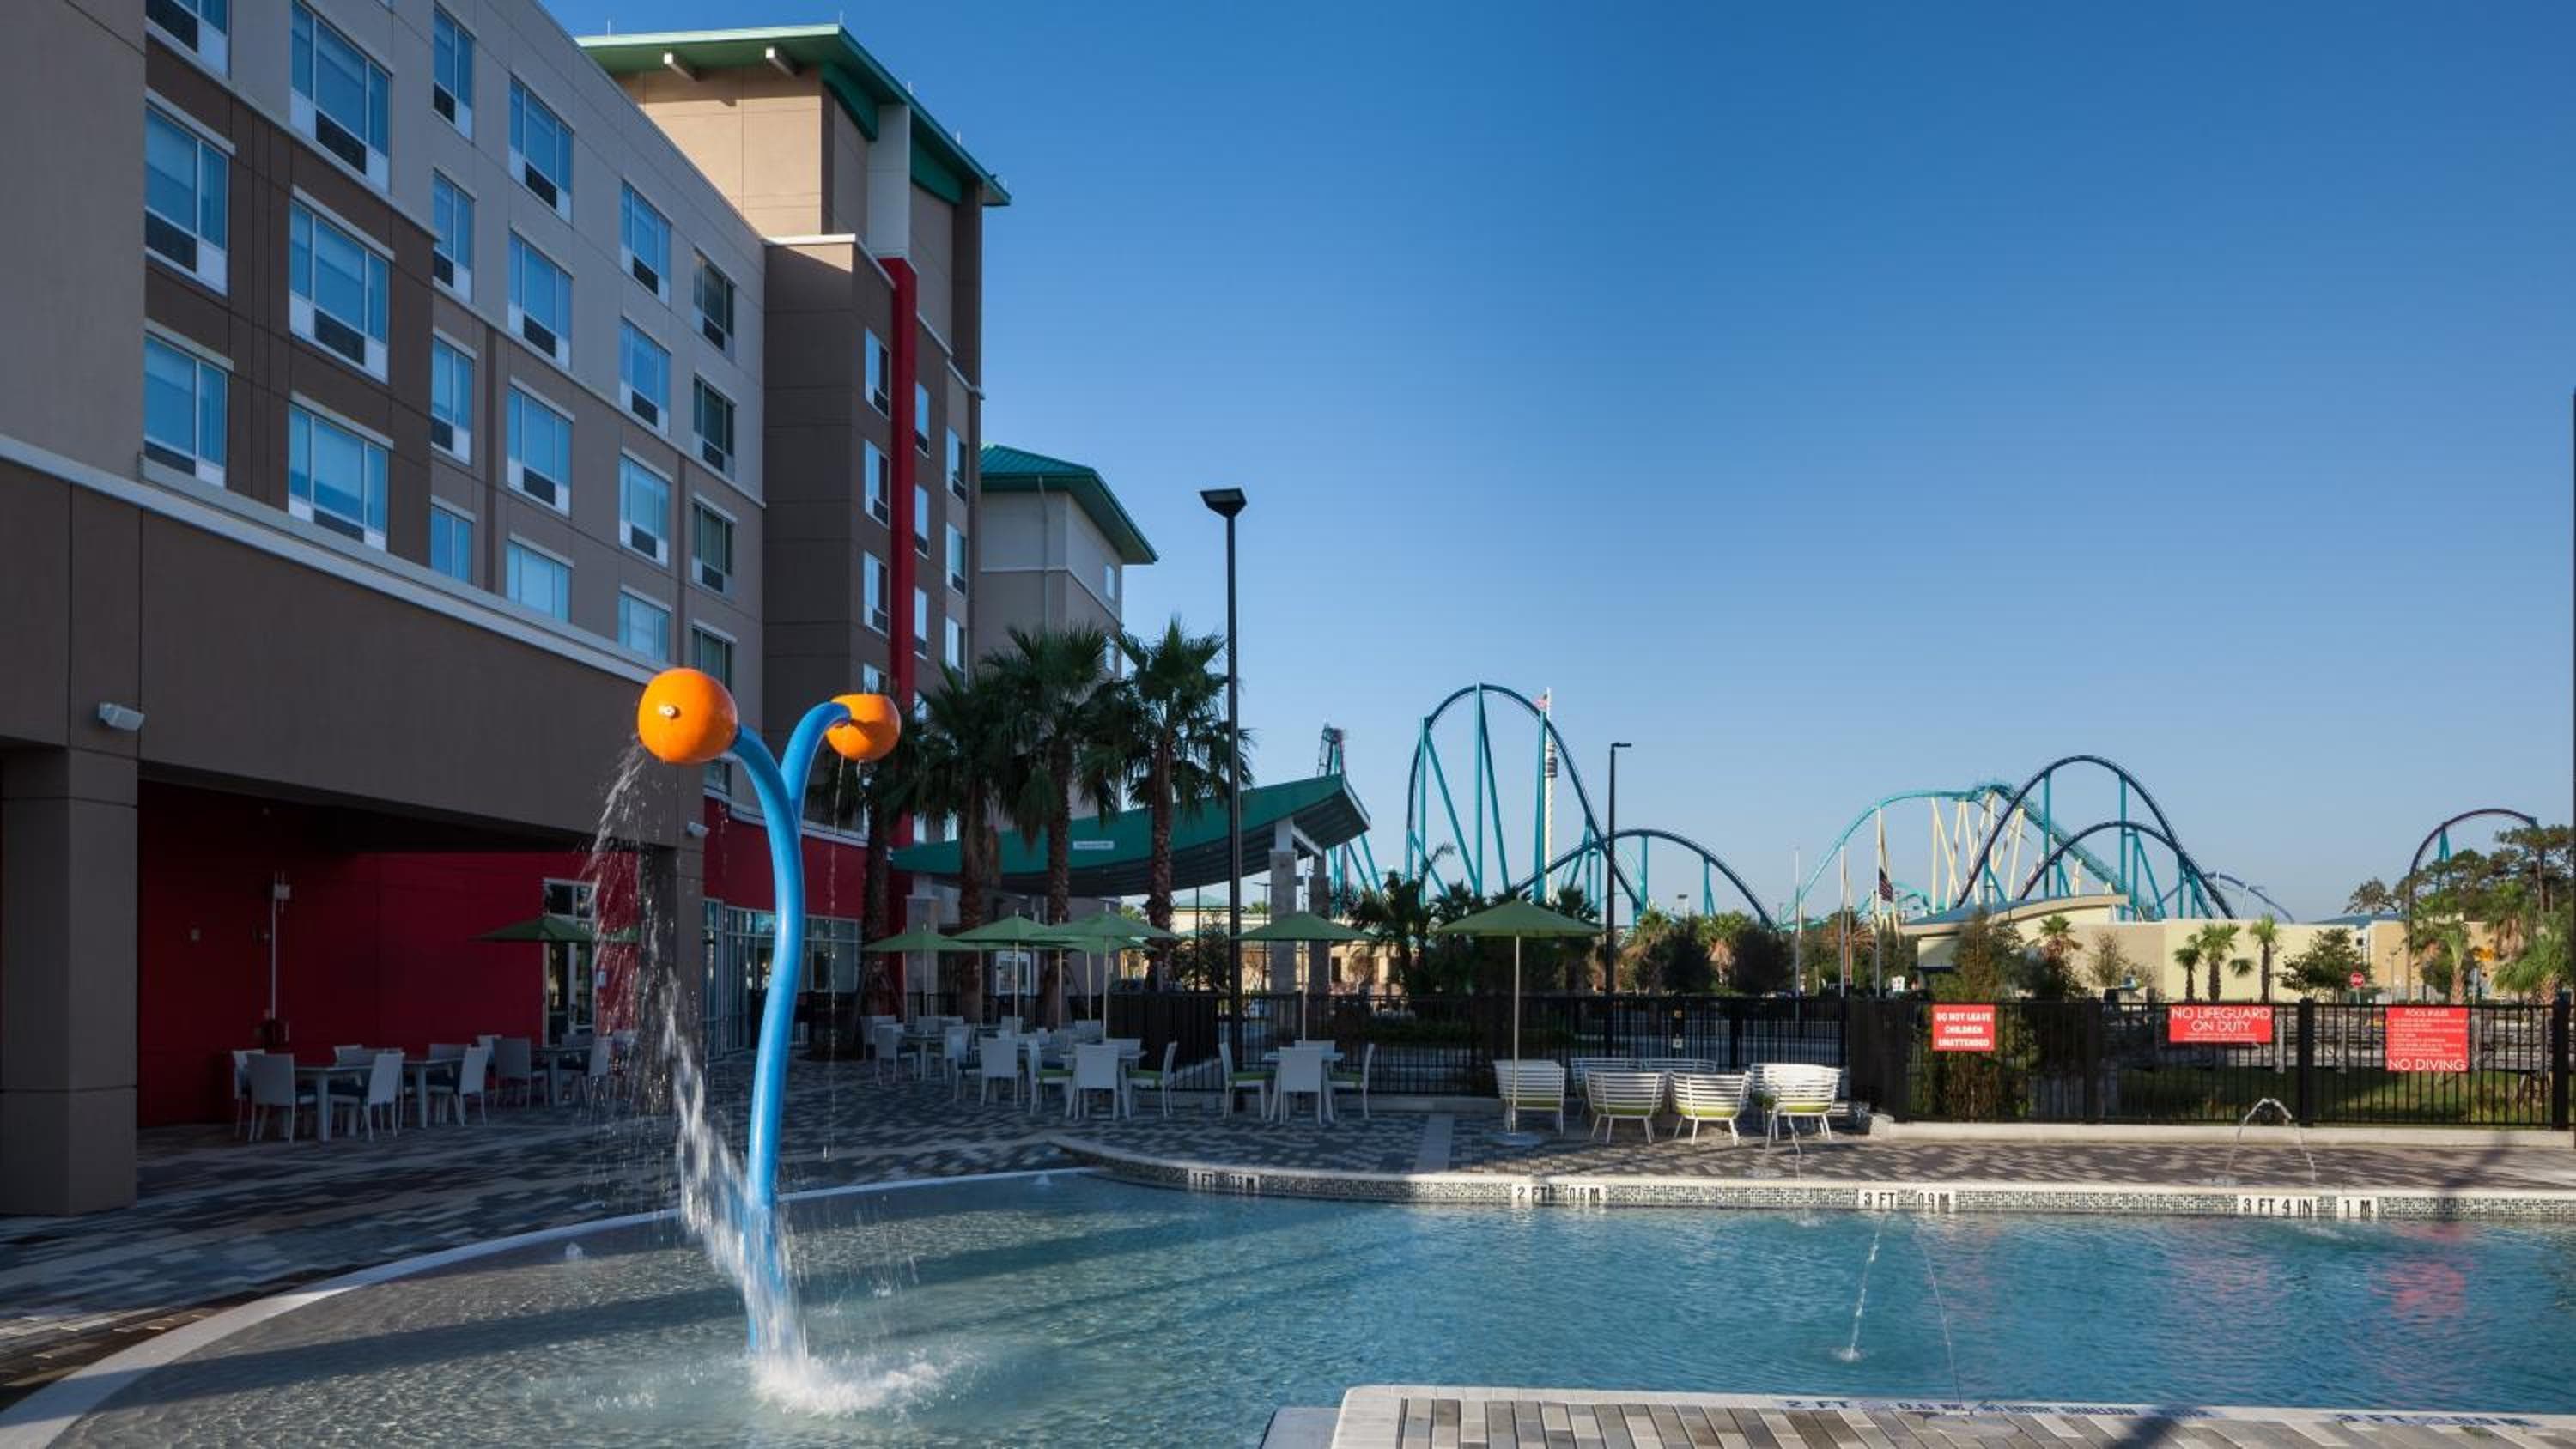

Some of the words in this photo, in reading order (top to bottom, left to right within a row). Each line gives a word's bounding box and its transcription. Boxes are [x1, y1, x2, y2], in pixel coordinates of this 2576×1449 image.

[1966, 1013, 1991, 1022] LEAVE
[2172, 1008, 2194, 1019] NO
[2197, 1008, 2271, 1019] LIFEGUARD
[2191, 1020, 2214, 1032] ON
[2218, 1021, 2251, 1032] DUTY
[2388, 1058, 2411, 1070] NO
[2415, 1058, 2464, 1070] DIVING
[1517, 1186, 1525, 1199] 2
[1531, 1186, 1548, 1202] FT
[1864, 1192, 1873, 1206] 3
[1879, 1192, 1896, 1208] FT
[2244, 1198, 2251, 1212] 3
[2258, 1198, 2275, 1213] FT
[2281, 1198, 2291, 1216] 4
[2297, 1199, 2312, 1218] IN
[1785, 1400, 1802, 1409] 2
[1815, 1400, 1848, 1409] FT
